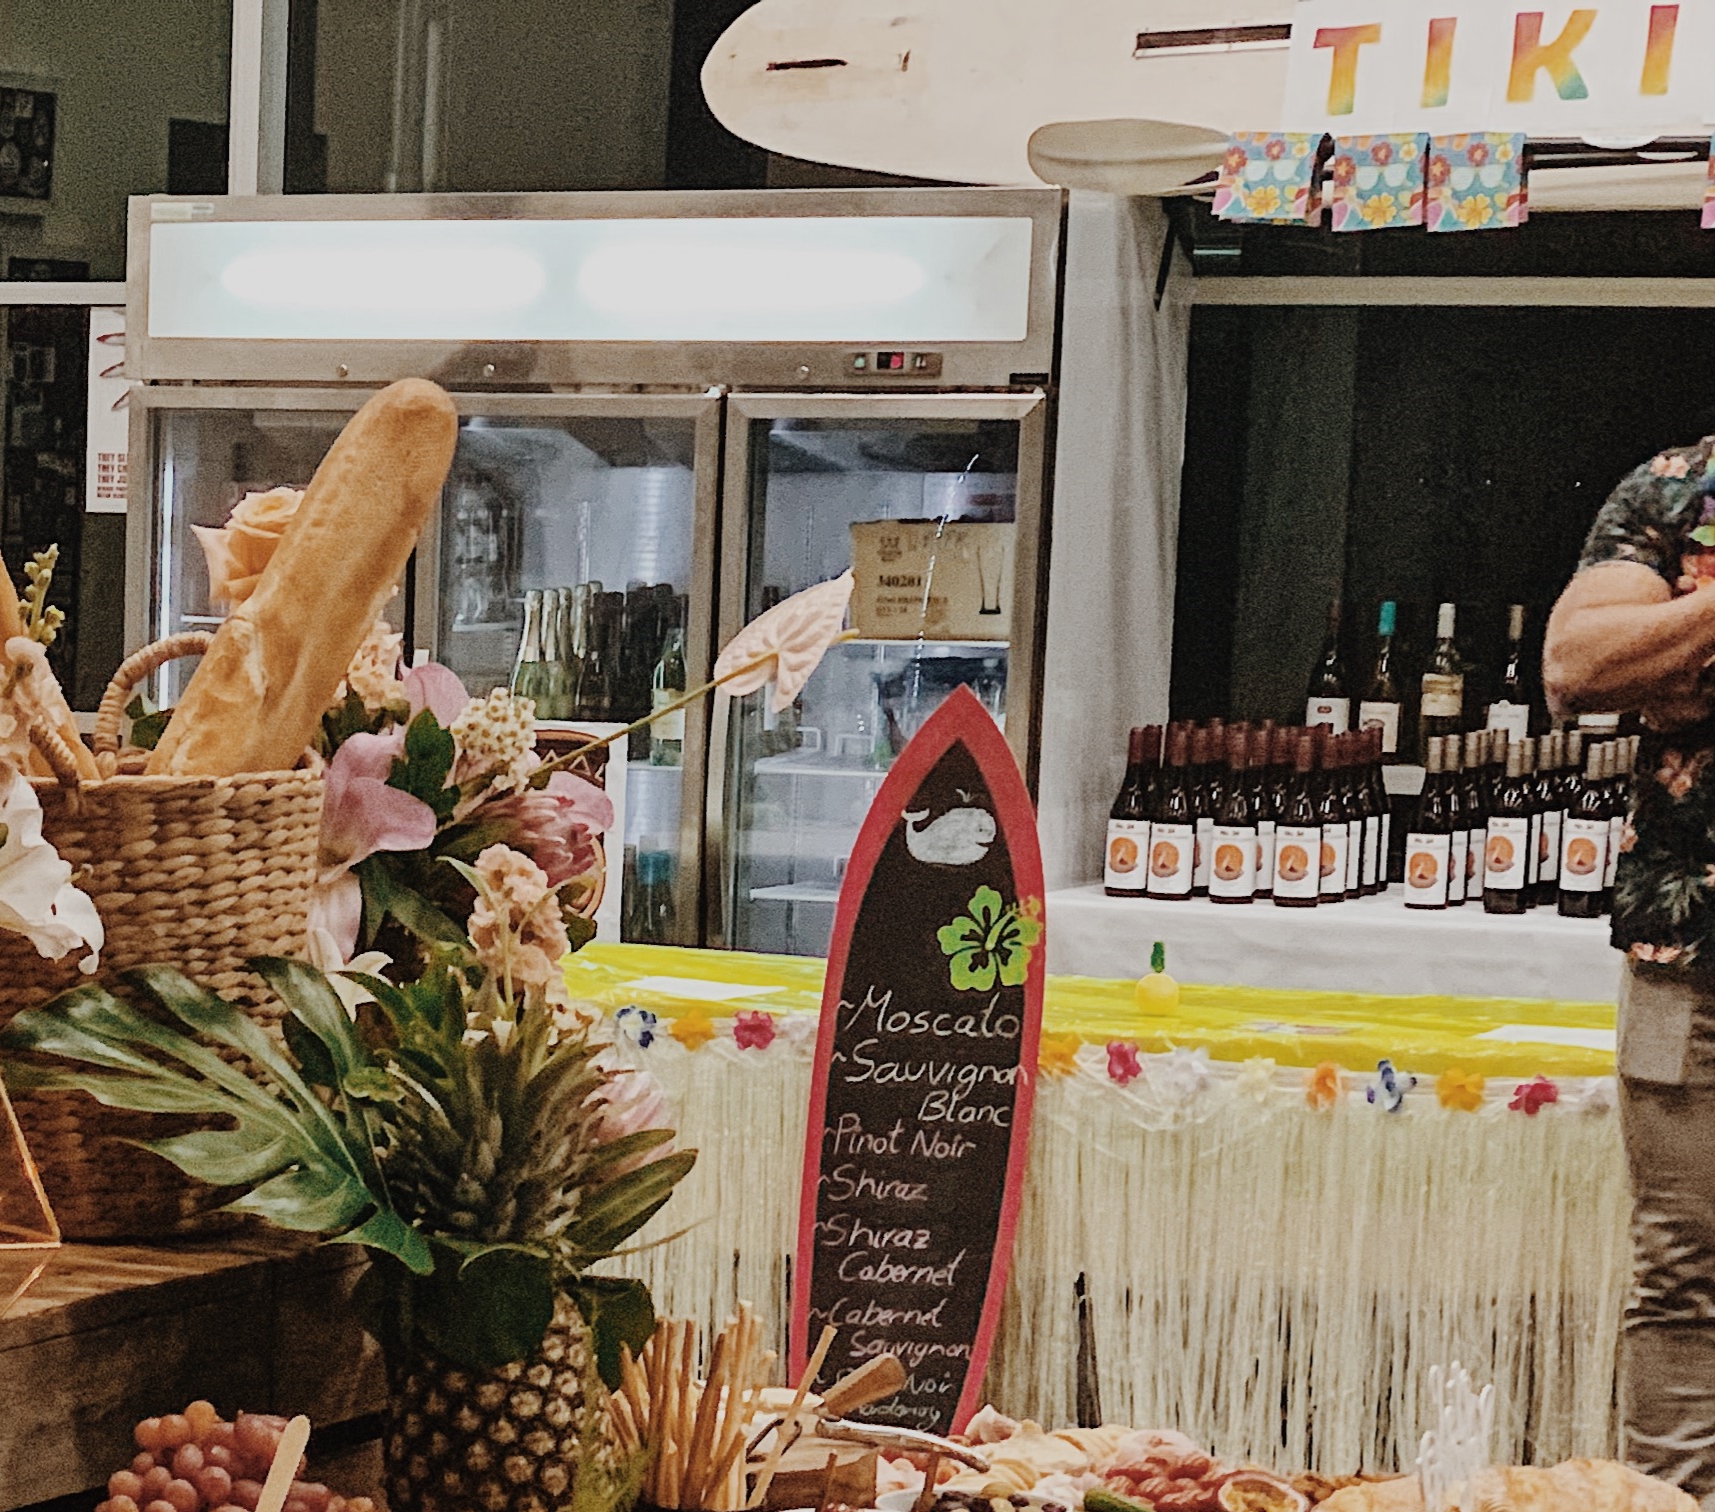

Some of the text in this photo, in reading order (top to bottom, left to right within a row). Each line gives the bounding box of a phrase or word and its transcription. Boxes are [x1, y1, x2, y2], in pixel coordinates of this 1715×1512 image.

[1313, 4, 1680, 116] TIKI
[844, 984, 1021, 1039] Moscato
[844, 1038, 1030, 1096] Sauvignon
[917, 1089, 1012, 1128] Blanc
[832, 1112, 977, 1160] Pinot Noir
[827, 1163, 929, 1203] Shiraz
[821, 1213, 931, 1250] Shiraz
[837, 1248, 967, 1288] Cabernet
[828, 1297, 950, 1328] Cabernet
[848, 1329, 972, 1368] Sauvignon
[902, 1371, 954, 1395] Noir
